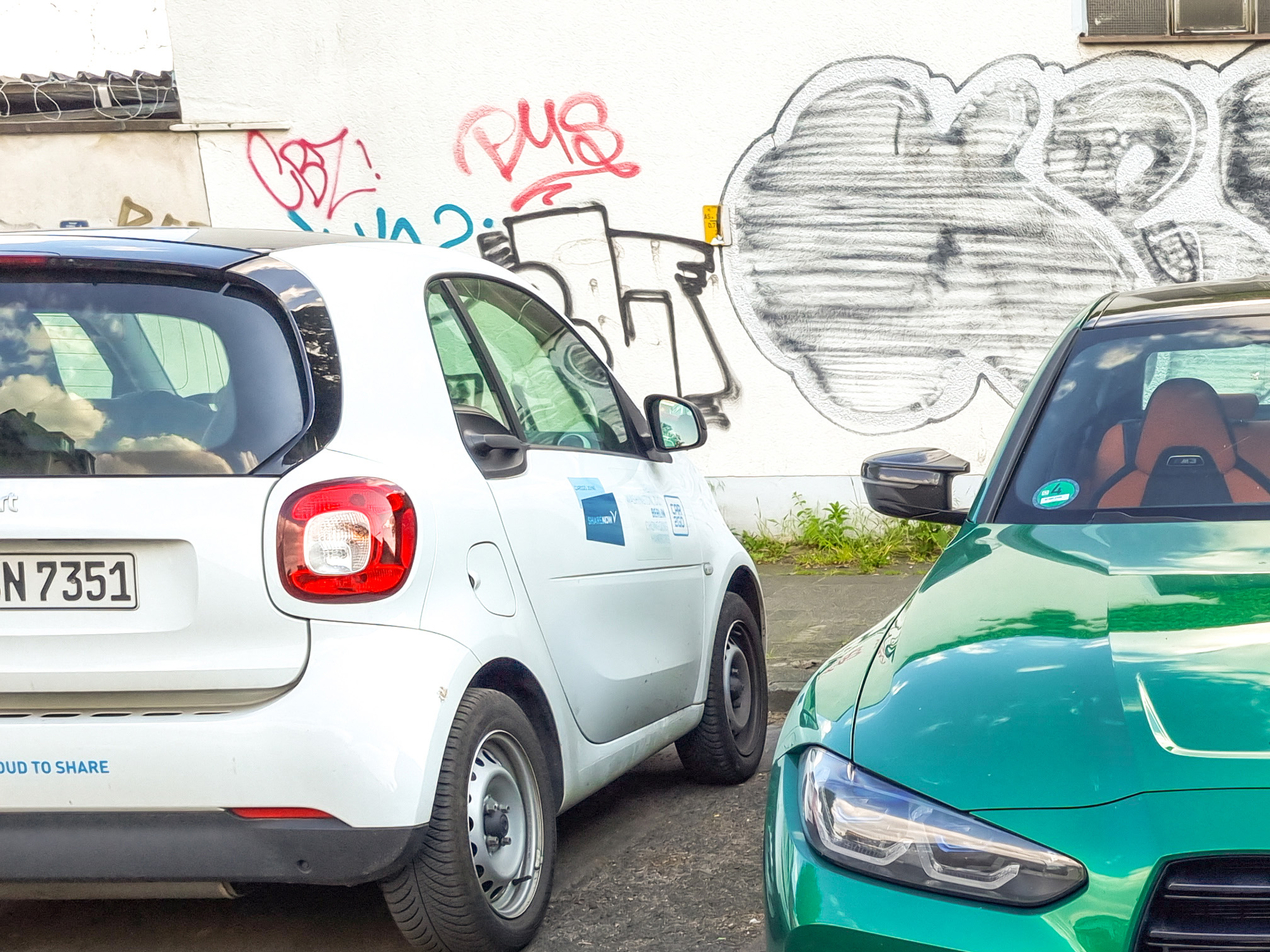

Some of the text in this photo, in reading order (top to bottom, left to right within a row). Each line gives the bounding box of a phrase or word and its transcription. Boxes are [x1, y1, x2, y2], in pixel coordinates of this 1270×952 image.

[37, 561, 131, 601] 7351
[31, 761, 51, 774] TO
[55, 760, 109, 774] SHARE
